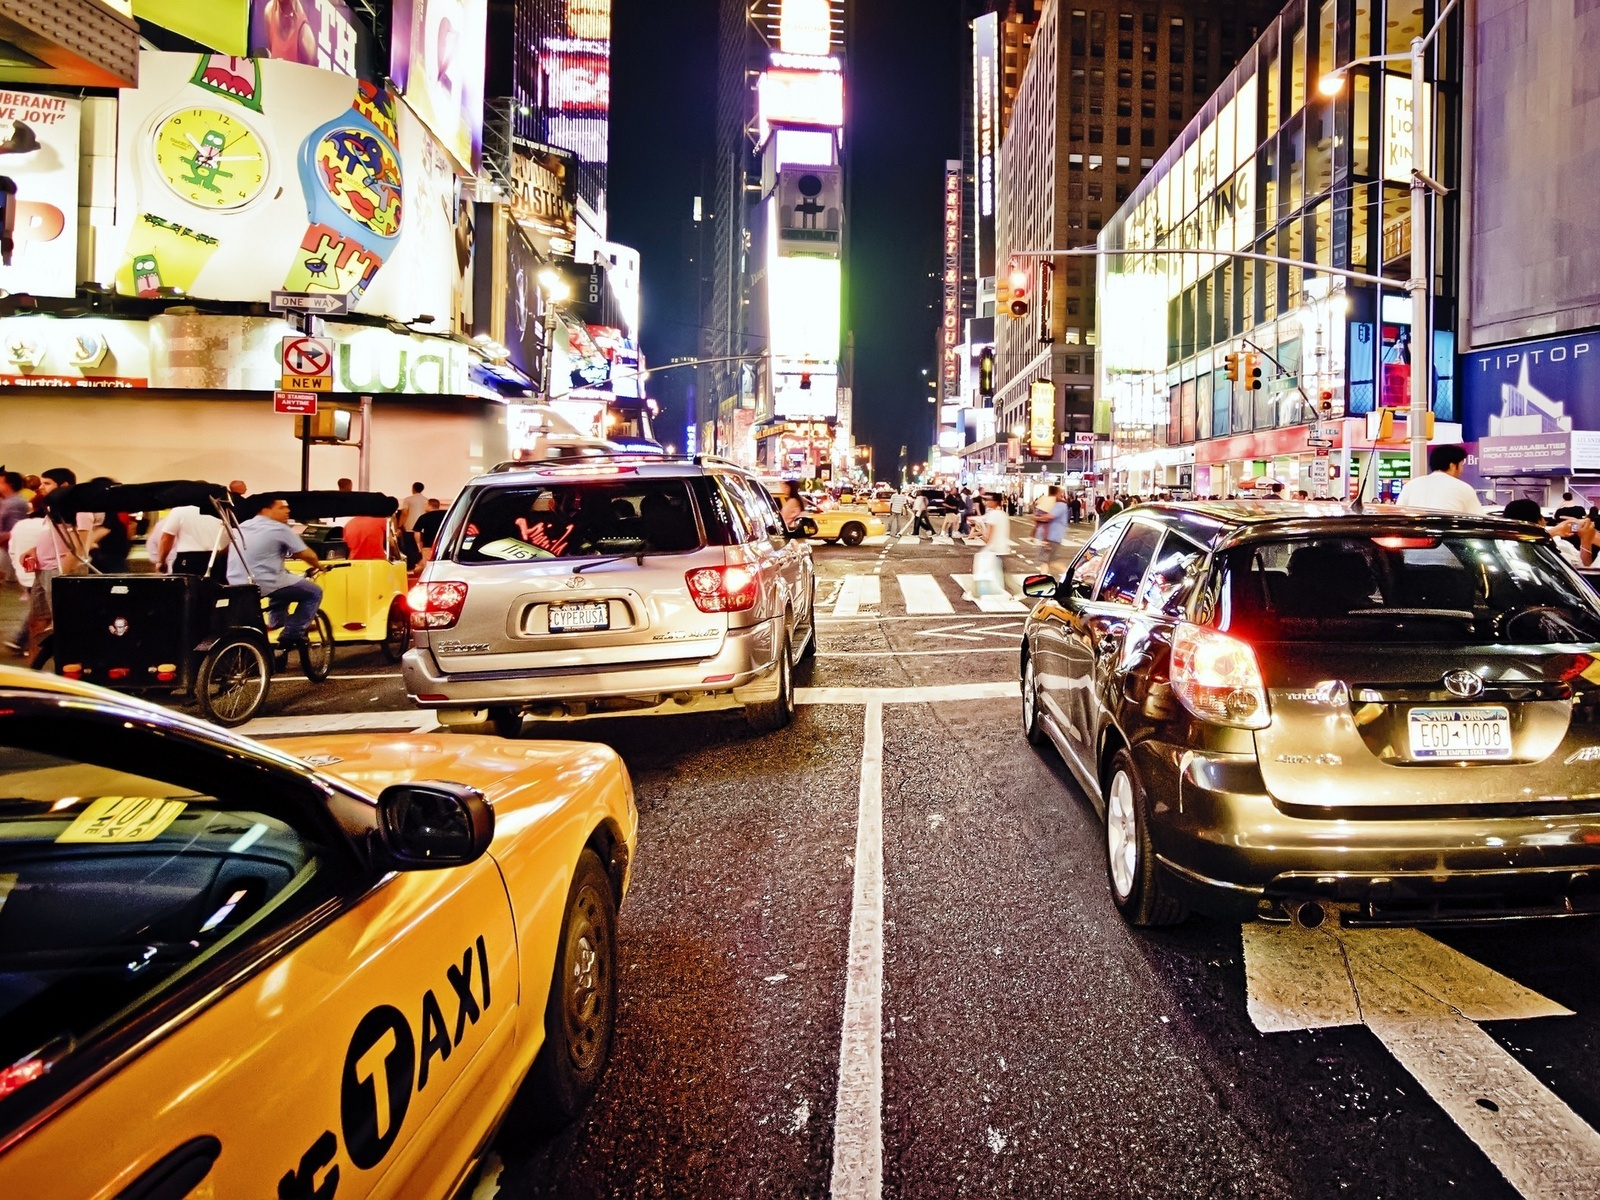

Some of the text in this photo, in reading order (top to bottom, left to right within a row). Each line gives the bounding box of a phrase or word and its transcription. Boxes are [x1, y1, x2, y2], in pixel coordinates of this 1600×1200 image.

[982, 56, 991, 130] BLACKBERRY
[1396, 97, 1413, 112] TH
[218, 114, 230, 125] 12
[1391, 115, 1413, 138] LIO
[982, 131, 991, 155] FOR
[1390, 142, 1413, 165] KIN
[1193, 149, 1215, 193] THE
[1206, 172, 1248, 245] KING
[589, 264, 599, 303] 1500
[944, 175, 958, 378] ERNST & YOUNG
[281, 297, 336, 308] ONE WAY
[1479, 343, 1589, 372] TIP TOP
[292, 378, 323, 389] NEW
[1508, 442, 1566, 452] AVAILABILITIES
[553, 609, 604, 626] CYPERUSA
[1433, 711, 1485, 721] NEW YORK
